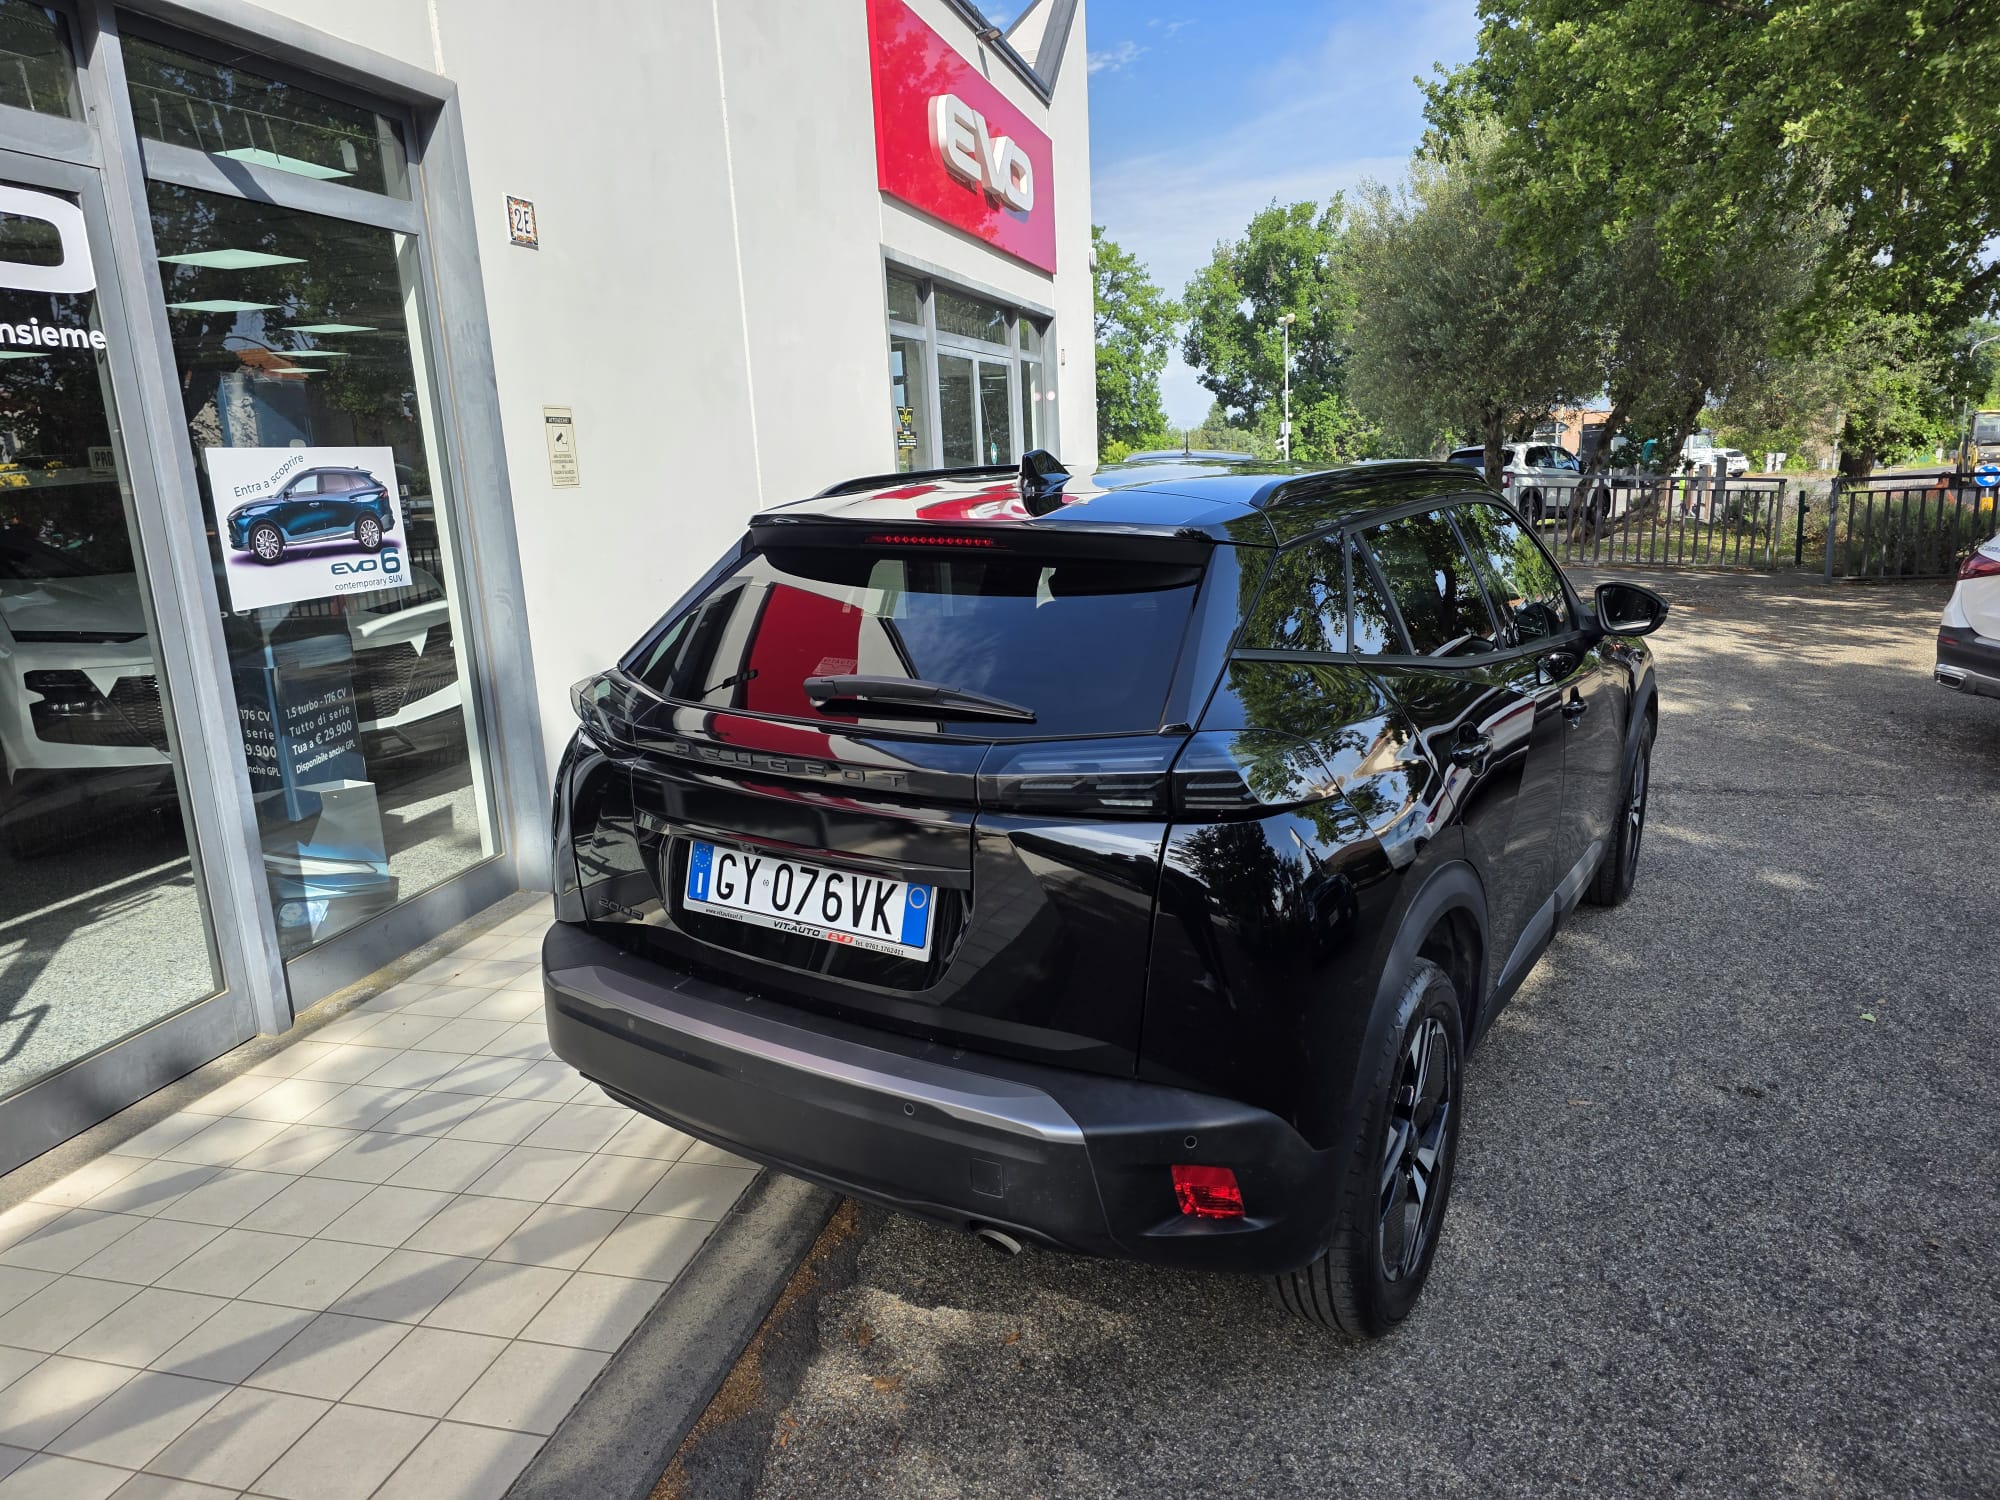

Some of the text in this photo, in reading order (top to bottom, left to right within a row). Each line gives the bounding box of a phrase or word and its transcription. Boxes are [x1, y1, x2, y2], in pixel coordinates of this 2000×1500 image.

[936, 94, 1034, 212] EVO
[514, 208, 531, 234] 2E
[233, 455, 304, 497] Entra a scoprire
[331, 547, 401, 575] EVO 6
[334, 575, 403, 591] contemporary SUV
[240, 709, 270, 722] 176 CV
[286, 707, 297, 719] 1.5
[297, 700, 319, 715] turbo
[324, 691, 336, 705] 176
[337, 688, 346, 699] CV
[246, 728, 275, 740] serie
[289, 705, 350, 737] Tutto di serie
[292, 743, 308, 756] Tua
[309, 740, 315, 749] a
[324, 720, 352, 741] 29.900
[266, 767, 281, 777] GPL
[296, 739, 356, 774] Disponibile anche GPL
[672, 741, 908, 787] PEUGEOT
[716, 853, 762, 905] GY
[771, 863, 898, 935] 076VK
[773, 921, 820, 937] VIT.AUTO
[827, 932, 854, 944] EVO
